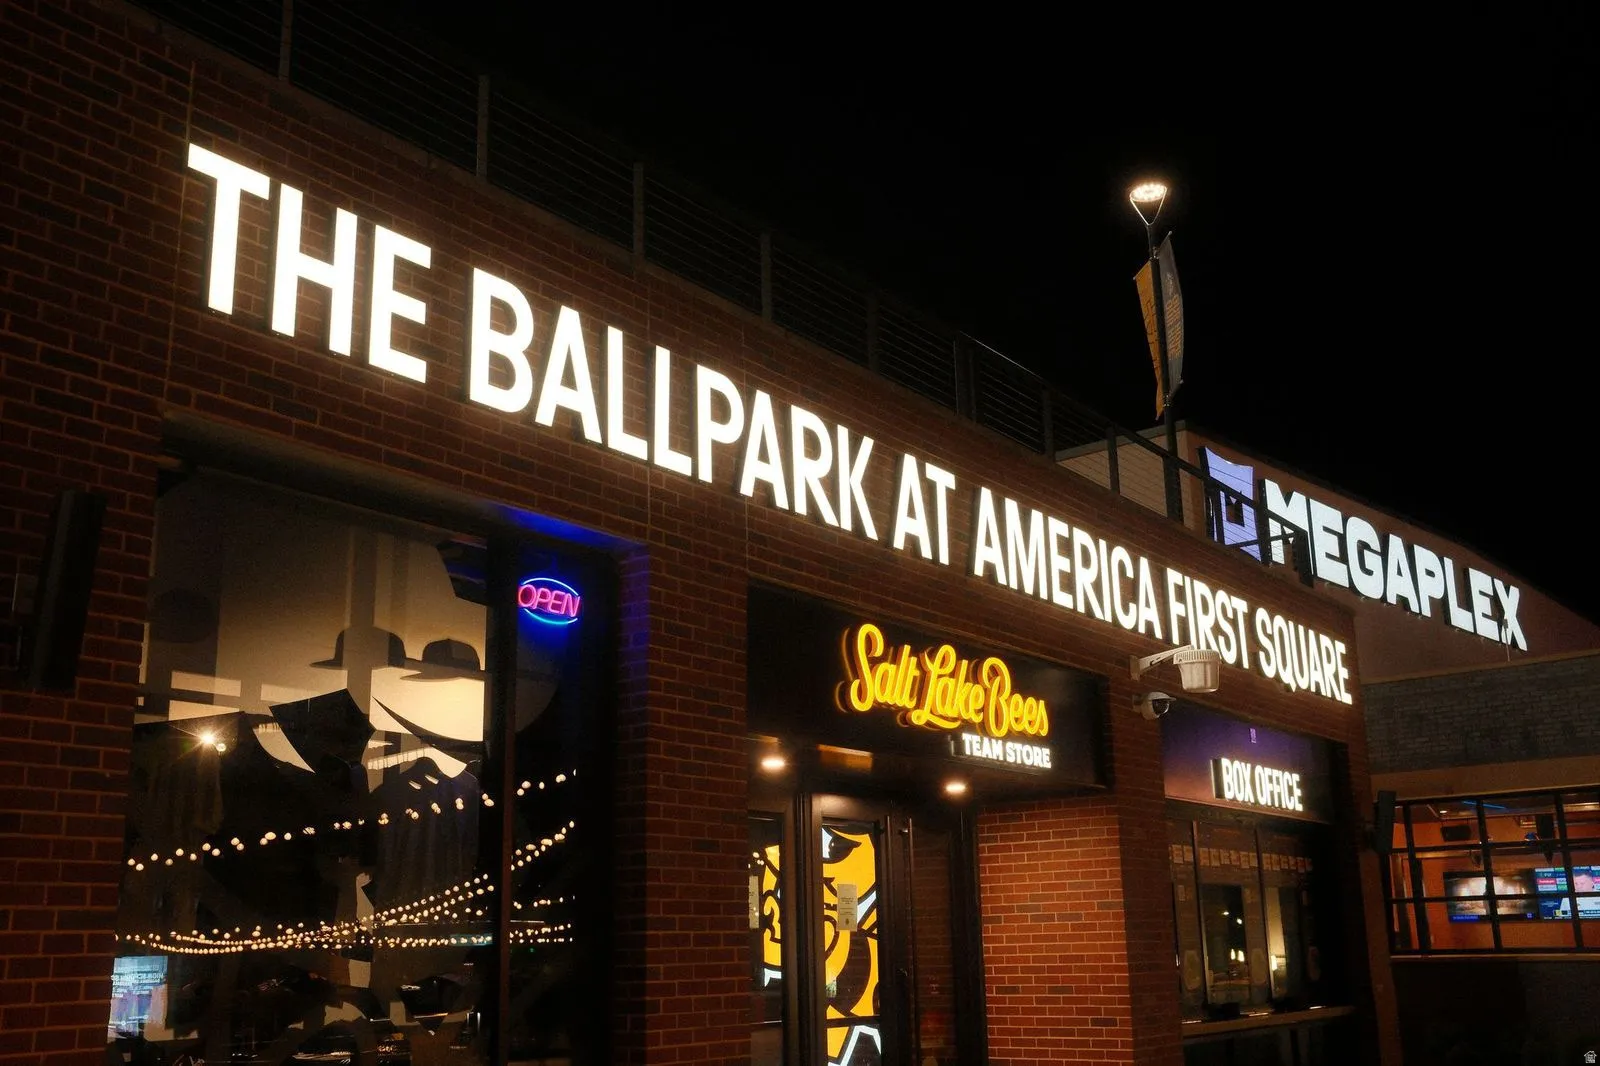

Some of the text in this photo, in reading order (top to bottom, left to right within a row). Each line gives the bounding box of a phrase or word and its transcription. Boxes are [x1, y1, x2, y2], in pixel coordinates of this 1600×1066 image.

[187, 142, 1353, 706] THE BALLPARK AT AMERICA FIRST SQUARE
[517, 584, 581, 618] OPEN
[1263, 478, 1527, 651] MEGAPLEX
[850, 623, 1049, 738] Salt Lake Bees
[962, 733, 1052, 769] TEAM STORE
[1221, 757, 1303, 812] BOX OFFICE
